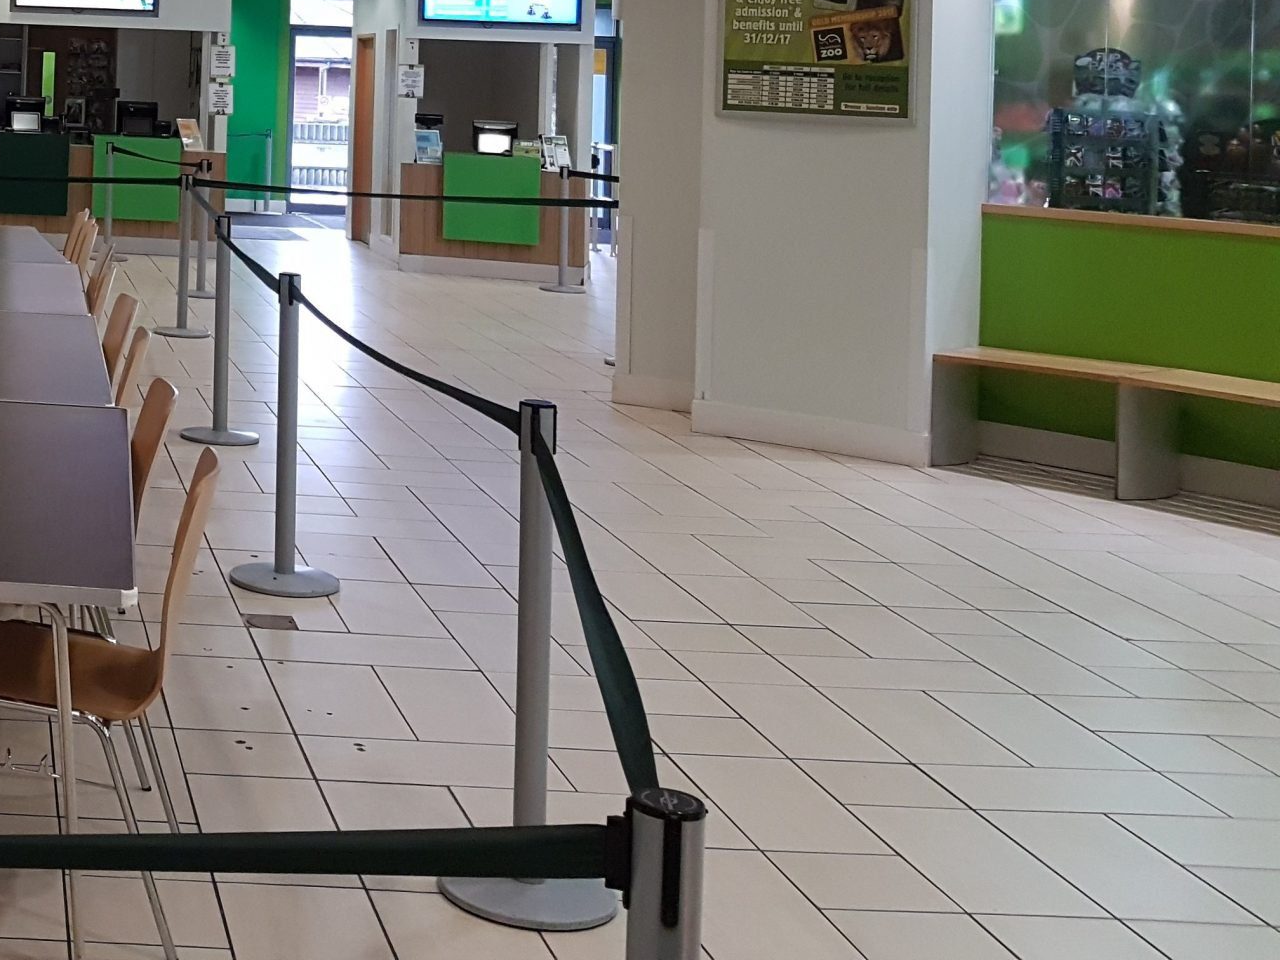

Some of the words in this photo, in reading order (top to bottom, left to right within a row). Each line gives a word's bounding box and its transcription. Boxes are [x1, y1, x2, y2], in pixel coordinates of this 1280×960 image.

[793, 7, 802, 18] &
[732, 19, 776, 31] benefits
[778, 20, 804, 32] until
[743, 32, 791, 45] 31/12/17
[820, 48, 843, 58] ZOO
